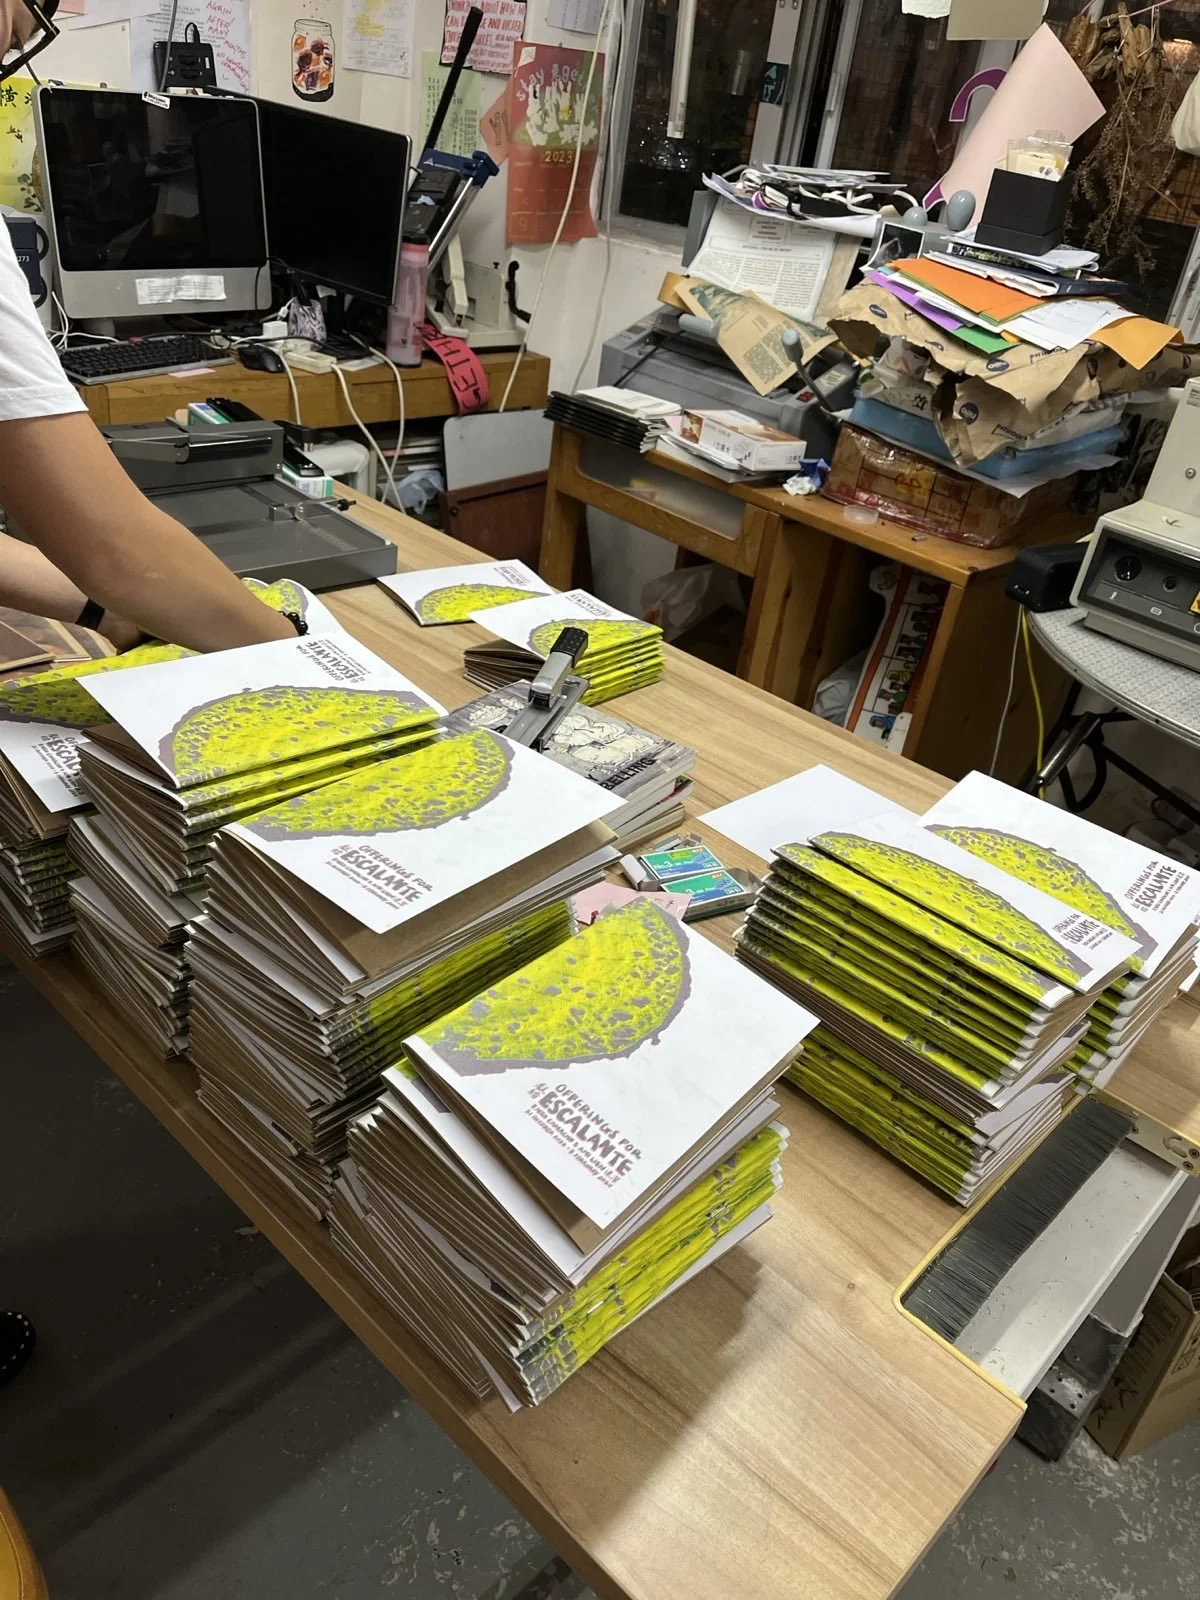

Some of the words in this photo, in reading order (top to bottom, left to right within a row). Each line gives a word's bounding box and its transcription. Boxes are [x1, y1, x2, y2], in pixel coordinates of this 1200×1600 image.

[544, 150, 574, 164] 2023
[305, 641, 360, 679] ESCALANTE
[340, 849, 423, 902] ESCALANTE
[358, 844, 415, 879] OFFERINGS
[413, 877, 433, 892] FOR
[1135, 865, 1177, 908] ESCALANTE
[539, 1091, 633, 1176] ESCALANTE
[555, 1083, 620, 1139] OFFERINGS
[618, 1138, 642, 1160] FOR
